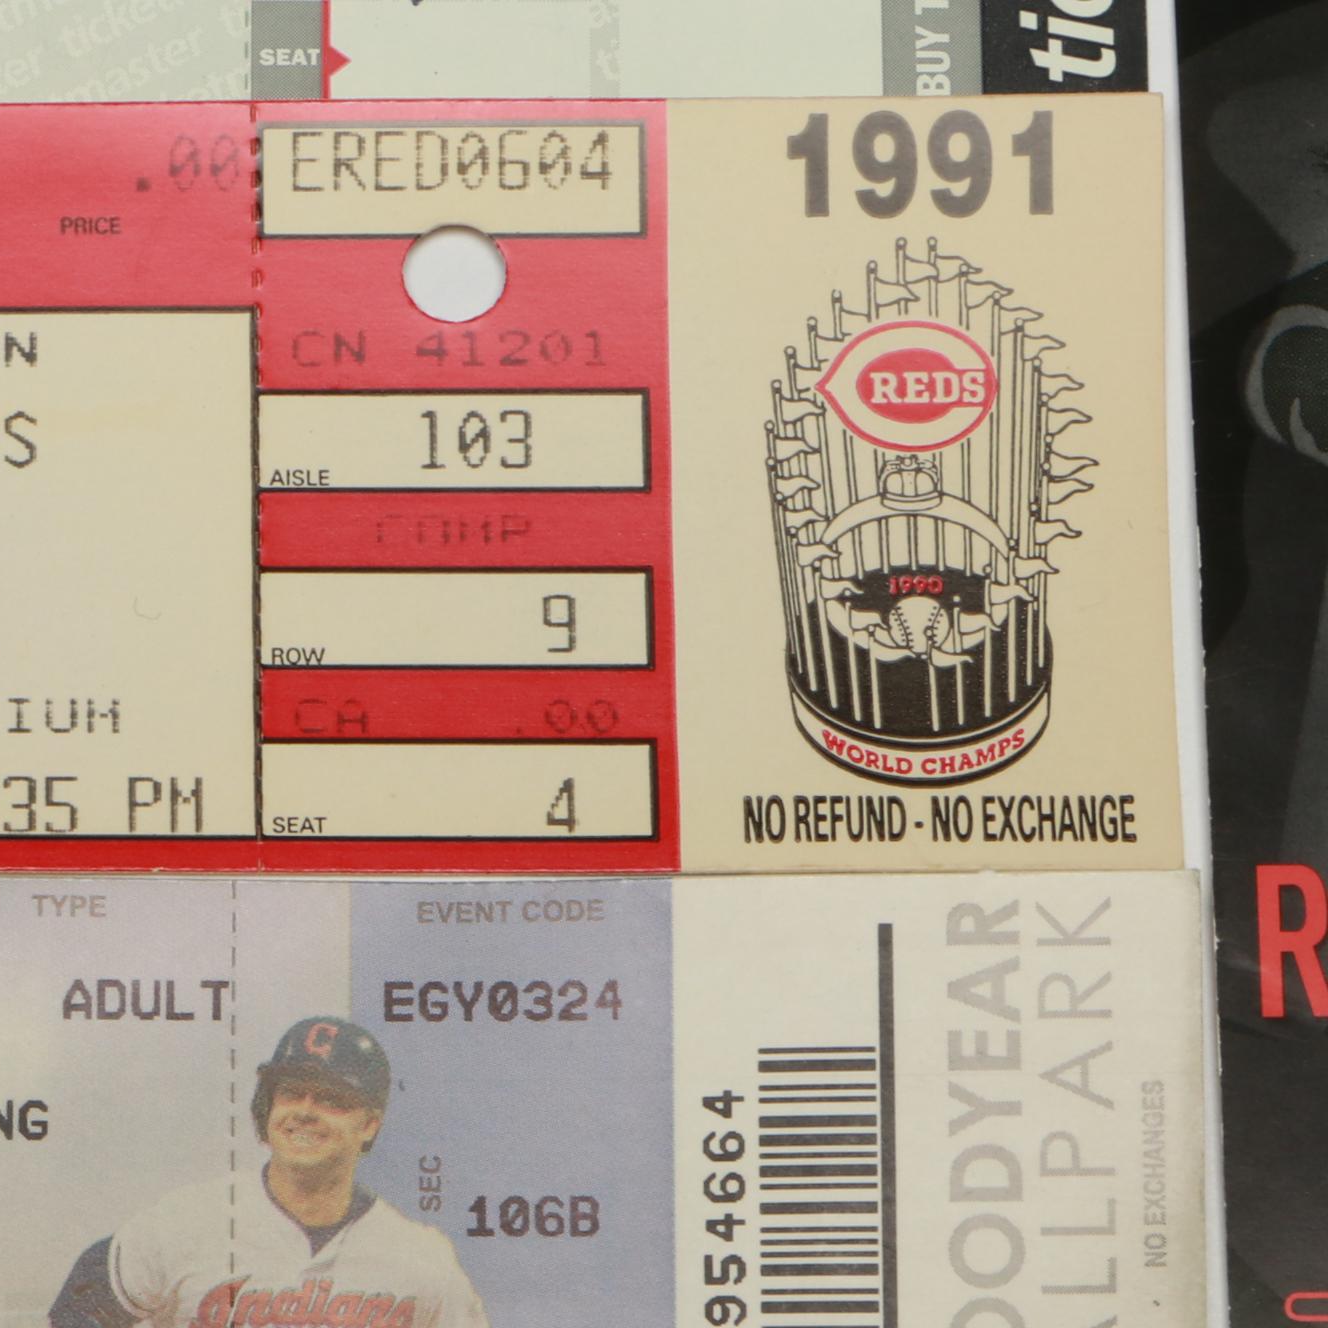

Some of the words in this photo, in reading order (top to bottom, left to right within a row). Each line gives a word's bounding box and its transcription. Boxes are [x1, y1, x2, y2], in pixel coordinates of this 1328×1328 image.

[260, 49, 320, 66] SEAT
[915, 26, 951, 95] BUY
[291, 131, 618, 191] ERED0604
[786, 110, 1054, 219] 1991
[60, 218, 121, 235] PRICE
[292, 330, 366, 367] CN
[416, 330, 607, 367] 41201
[871, 371, 986, 404] REDS
[421, 411, 532, 469] 103
[270, 470, 330, 486] AISLE
[889, 576, 943, 594] 1990
[543, 595, 576, 652] 9
[272, 648, 325, 665] ROW
[822, 730, 912, 775] WORLD
[921, 729, 1026, 775] CHAMPS
[129, 776, 204, 832] PM
[547, 777, 578, 833] 4
[744, 796, 786, 842] NO
[794, 796, 906, 842] REFUND
[932, 796, 972, 842] NO
[982, 795, 1136, 842] EXCHANGE
[273, 818, 327, 834] SEAT
[32, 895, 107, 918] TYPE
[417, 901, 512, 923] EVENT
[522, 899, 605, 922] CODE
[62, 979, 230, 1021] ADULT
[384, 980, 622, 1022] EGY0324
[1142, 1079, 1166, 1226] EXCHANGES
[419, 1155, 442, 1212] SEC
[466, 1195, 599, 1238] 106B
[1145, 1235, 1167, 1267] NO
